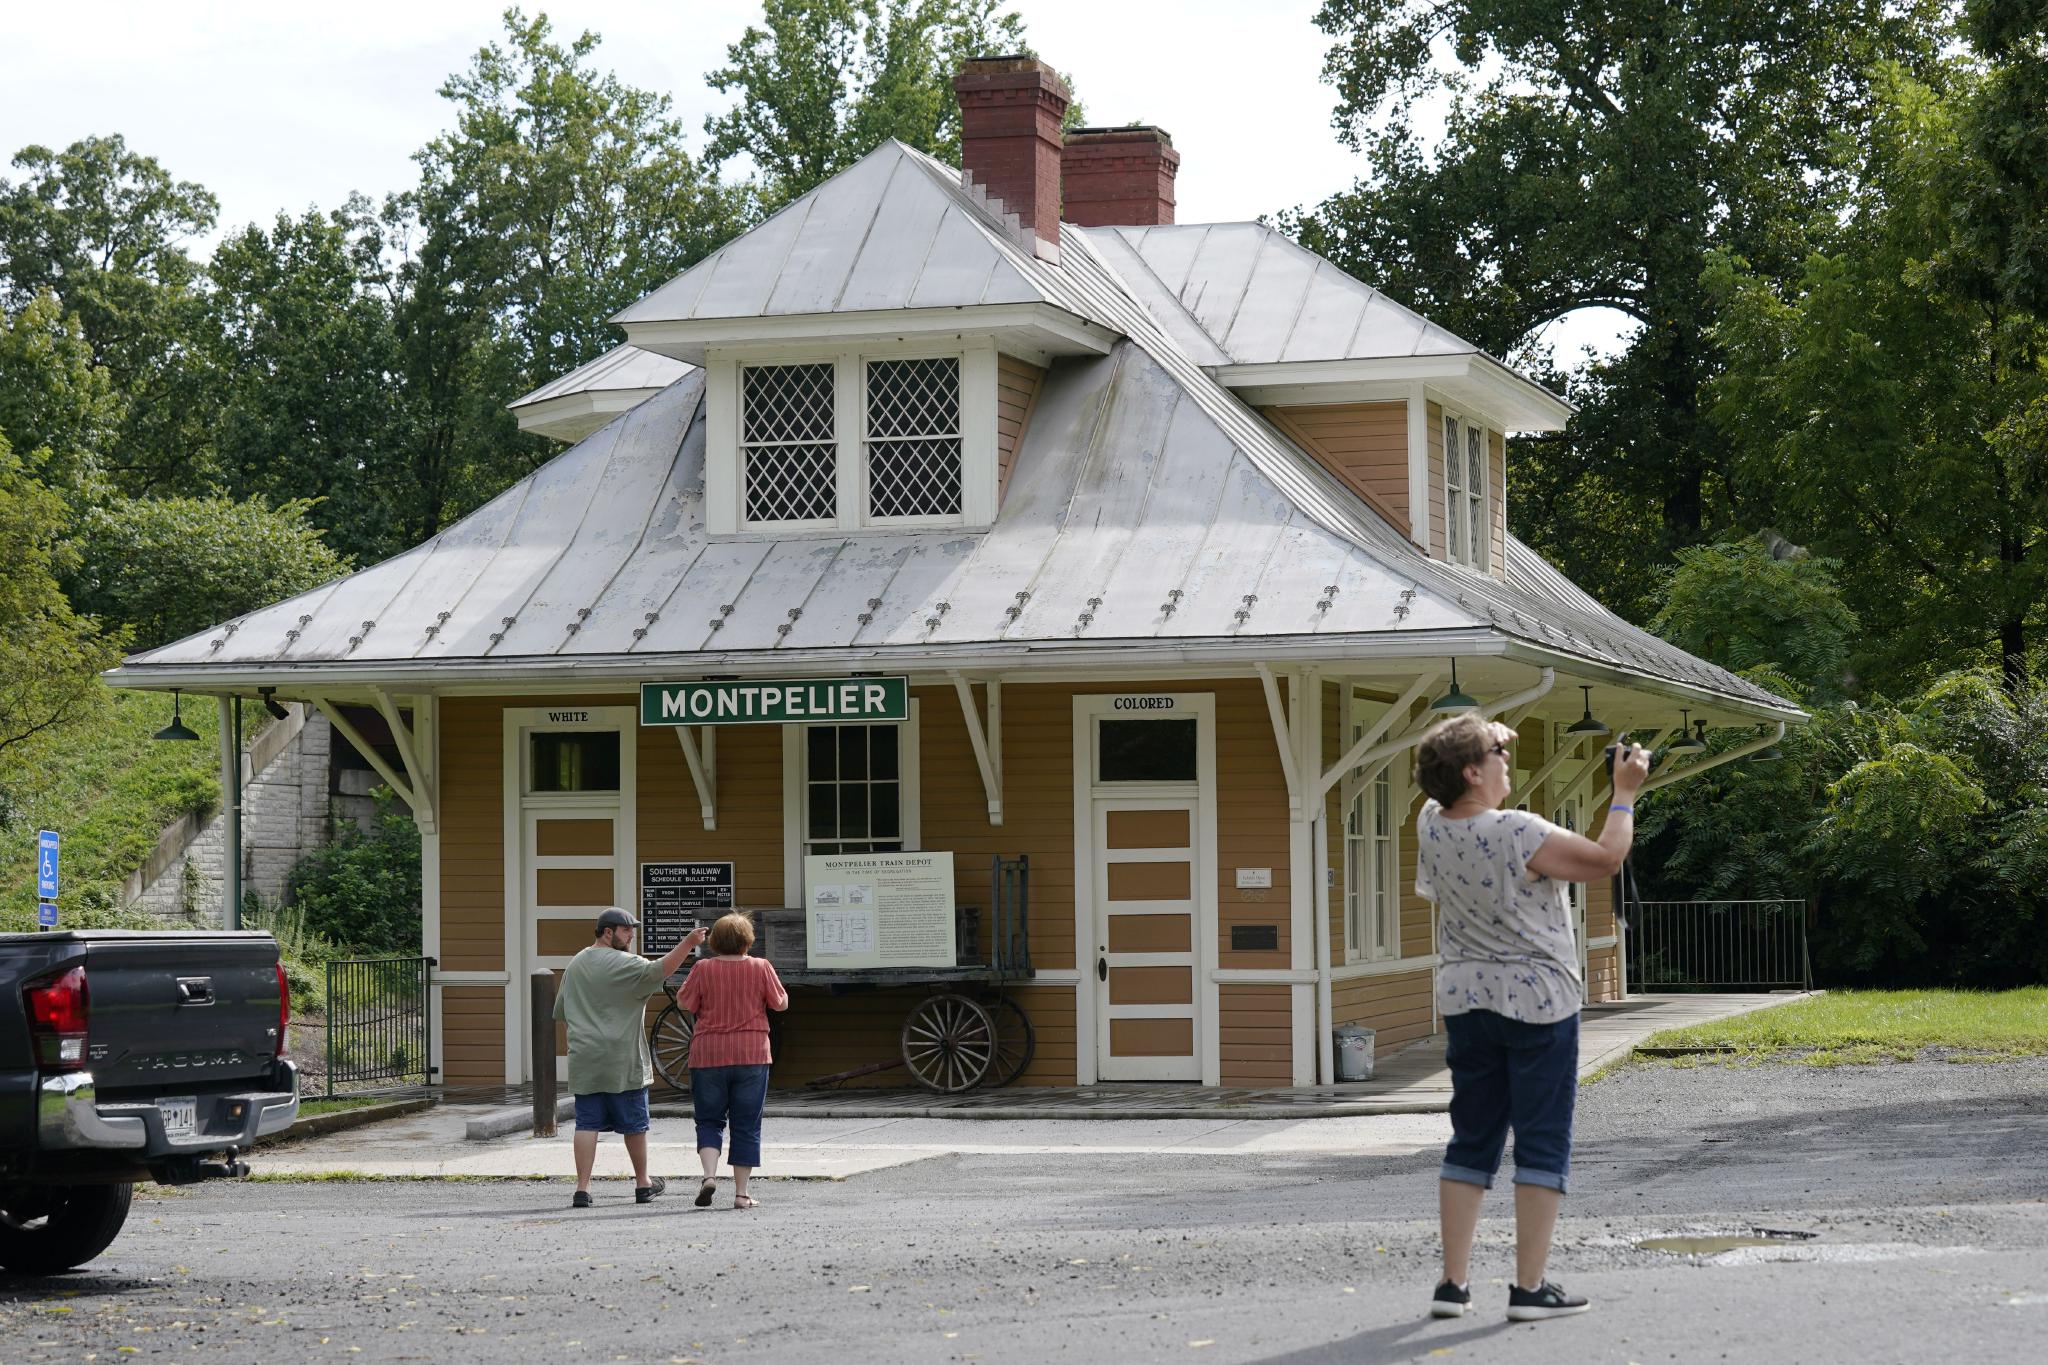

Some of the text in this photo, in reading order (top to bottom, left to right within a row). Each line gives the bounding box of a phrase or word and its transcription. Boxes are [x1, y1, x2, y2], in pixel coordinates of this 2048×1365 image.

[662, 685, 887, 718] MONTPELIER
[1114, 697, 1174, 710] COLORED
[548, 711, 589, 722] WHITE
[649, 867, 721, 876] SOUTHERN RAILWAY
[132, 1052, 242, 1070] TACOMA
[179, 1108, 193, 1126] 141
